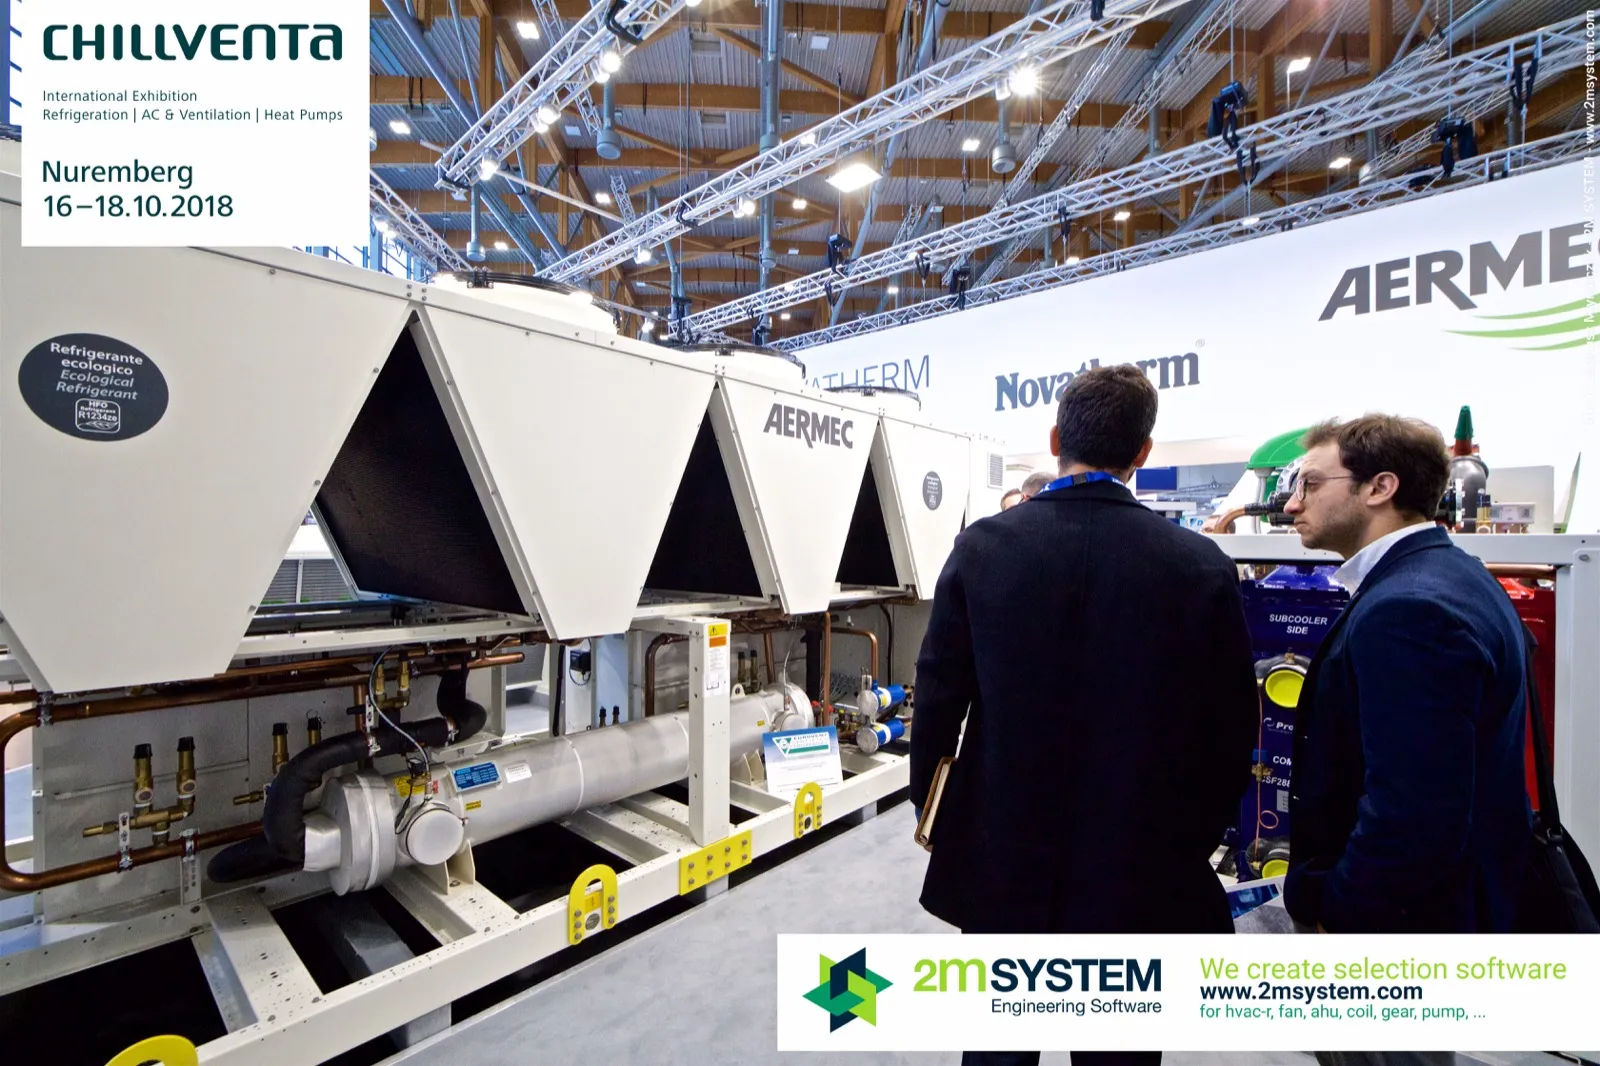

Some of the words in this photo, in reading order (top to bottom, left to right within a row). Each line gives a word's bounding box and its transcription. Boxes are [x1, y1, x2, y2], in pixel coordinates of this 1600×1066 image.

[1318, 220, 1600, 322] AERME
[50, 342, 143, 366] Refrigerante
[61, 358, 133, 376] ecologico
[60, 369, 135, 388] Ecological
[56, 381, 138, 400] Refrigerant
[88, 400, 108, 409] HFO
[78, 411, 118, 421] R1234ze
[763, 402, 853, 449] AERMEC
[1269, 613, 1328, 625] SUBCOOLER
[1286, 625, 1308, 635] SIDE
